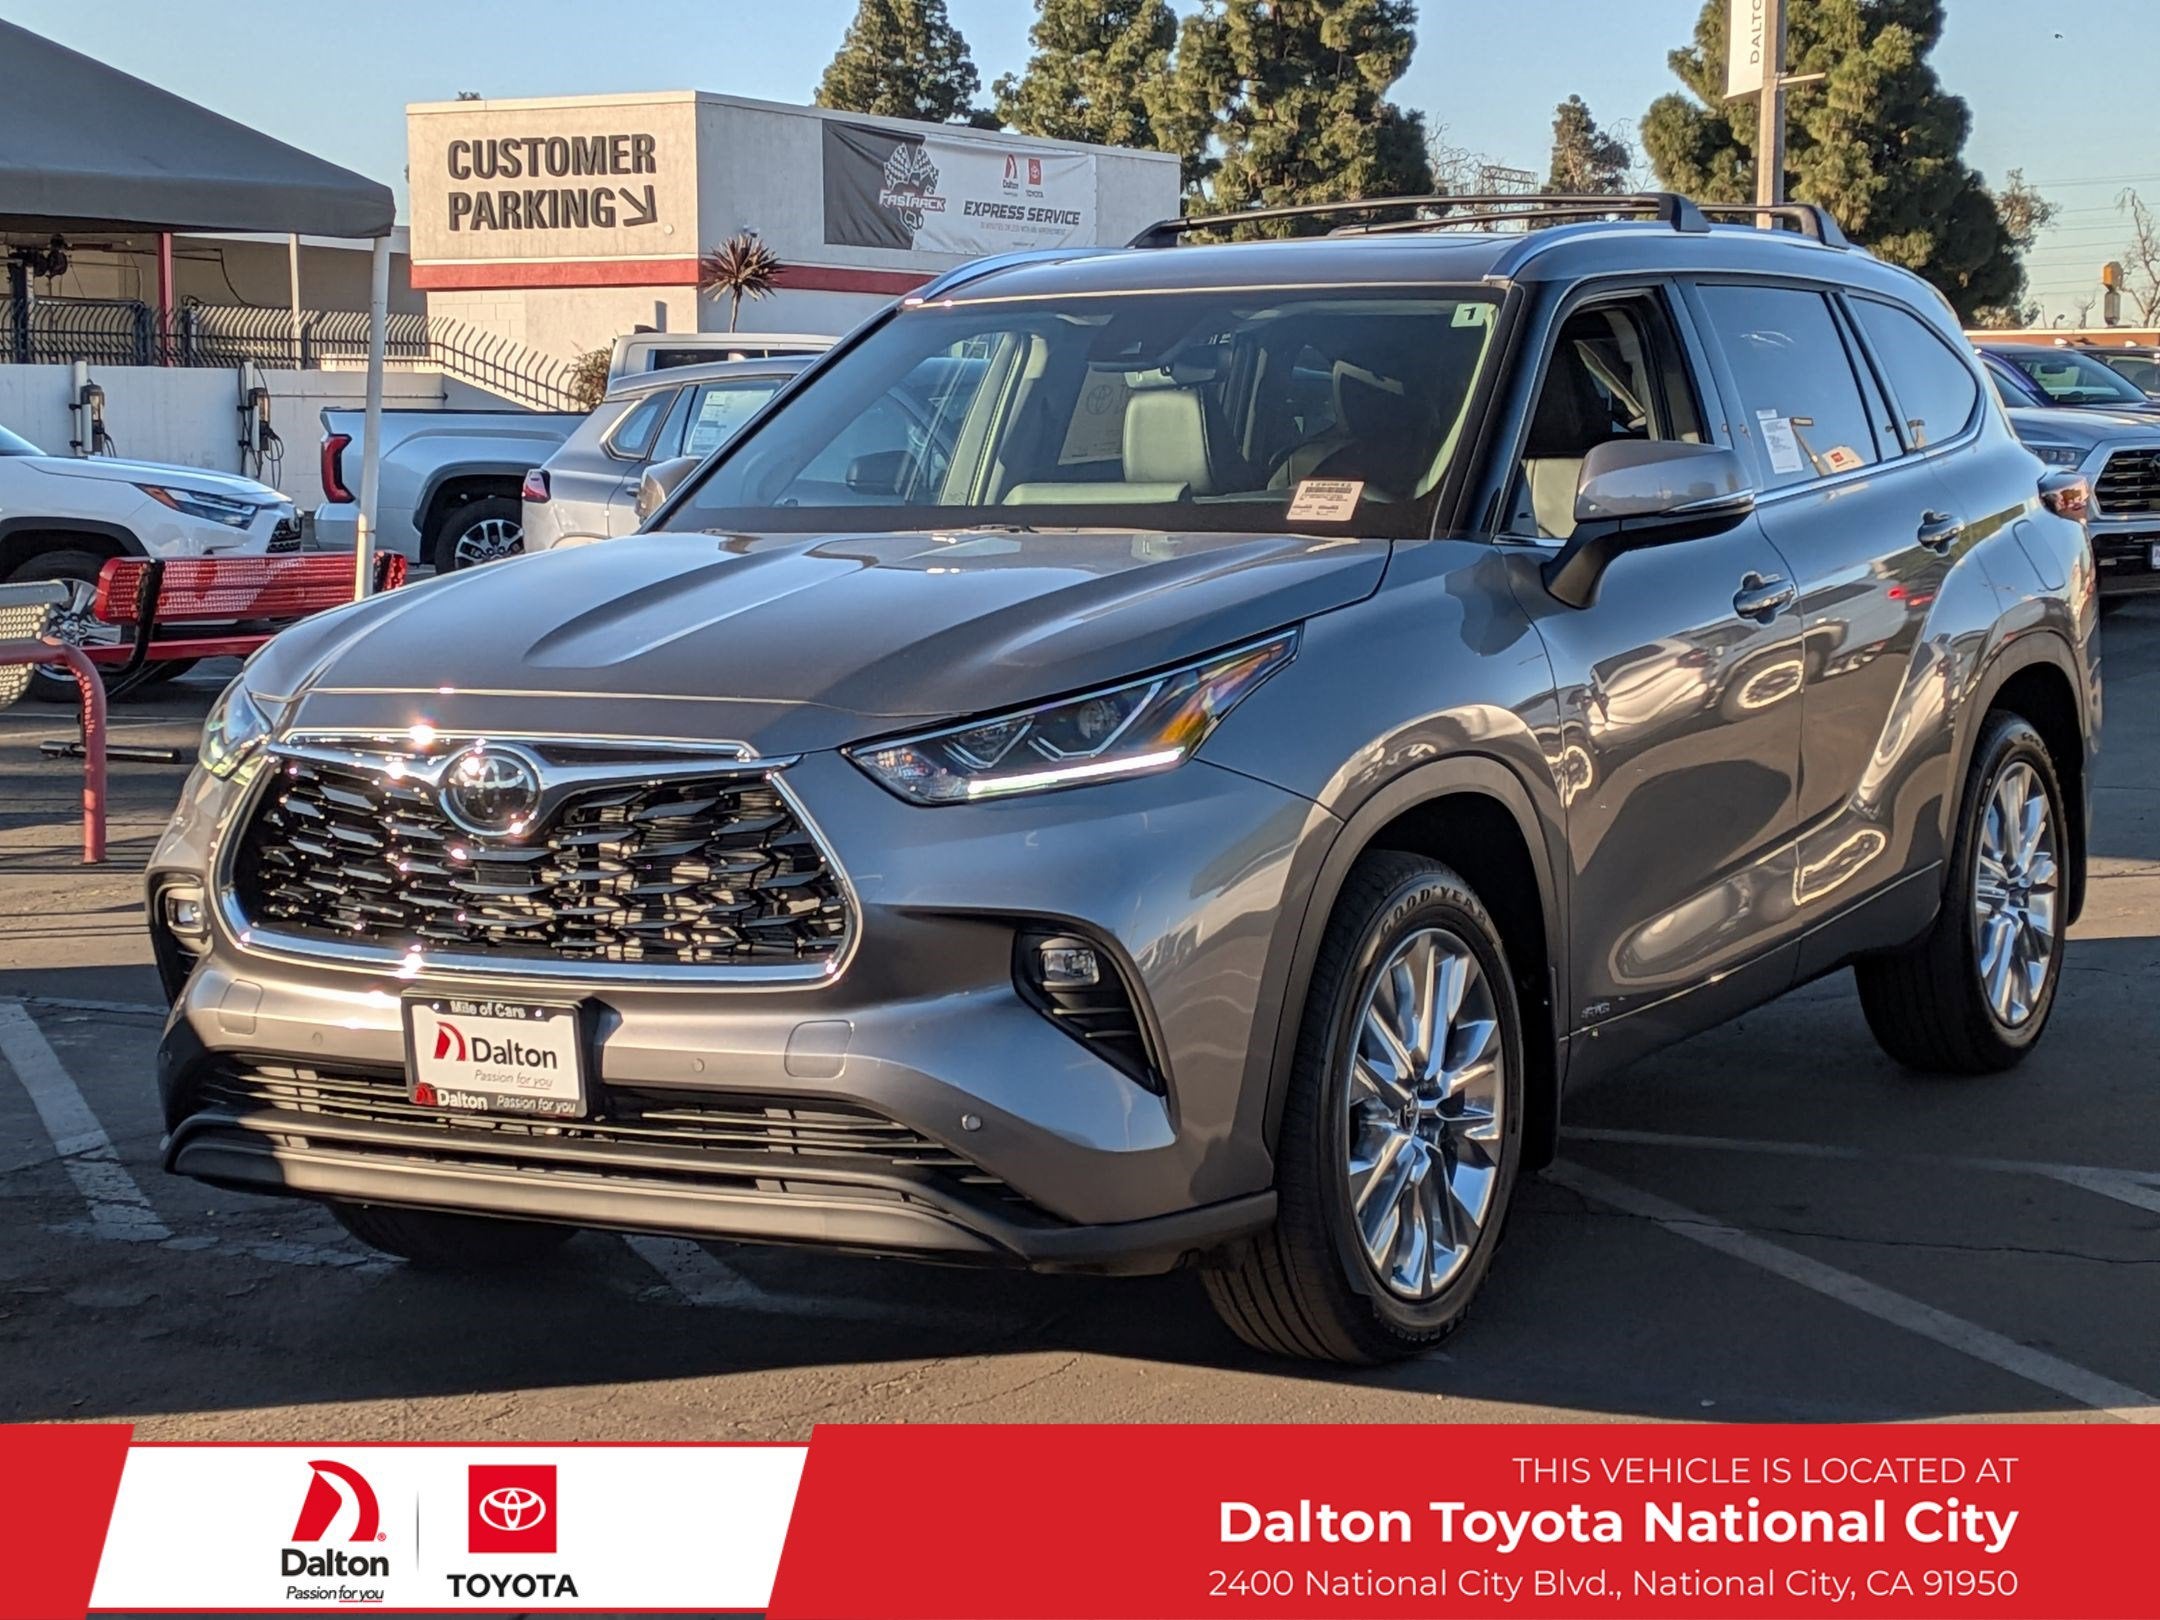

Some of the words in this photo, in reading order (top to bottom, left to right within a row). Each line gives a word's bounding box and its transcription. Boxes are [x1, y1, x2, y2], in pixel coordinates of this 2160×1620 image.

[448, 133, 657, 180] CUSTOMER
[448, 187, 616, 231] PARKING
[963, 201, 1025, 221] EXPRESS
[1027, 207, 1081, 225] SERVICE
[450, 1000, 476, 1016] Mile
[479, 1003, 493, 1016] of
[494, 1003, 526, 1019] Cars
[471, 1037, 558, 1070] Dalton
[474, 1069, 514, 1084] Passion
[516, 1072, 530, 1086] for
[533, 1076, 553, 1089] you
[437, 1089, 488, 1111] Dalton
[496, 1094, 536, 1111] Passion
[537, 1098, 554, 1113] for
[554, 1100, 576, 1114] you
